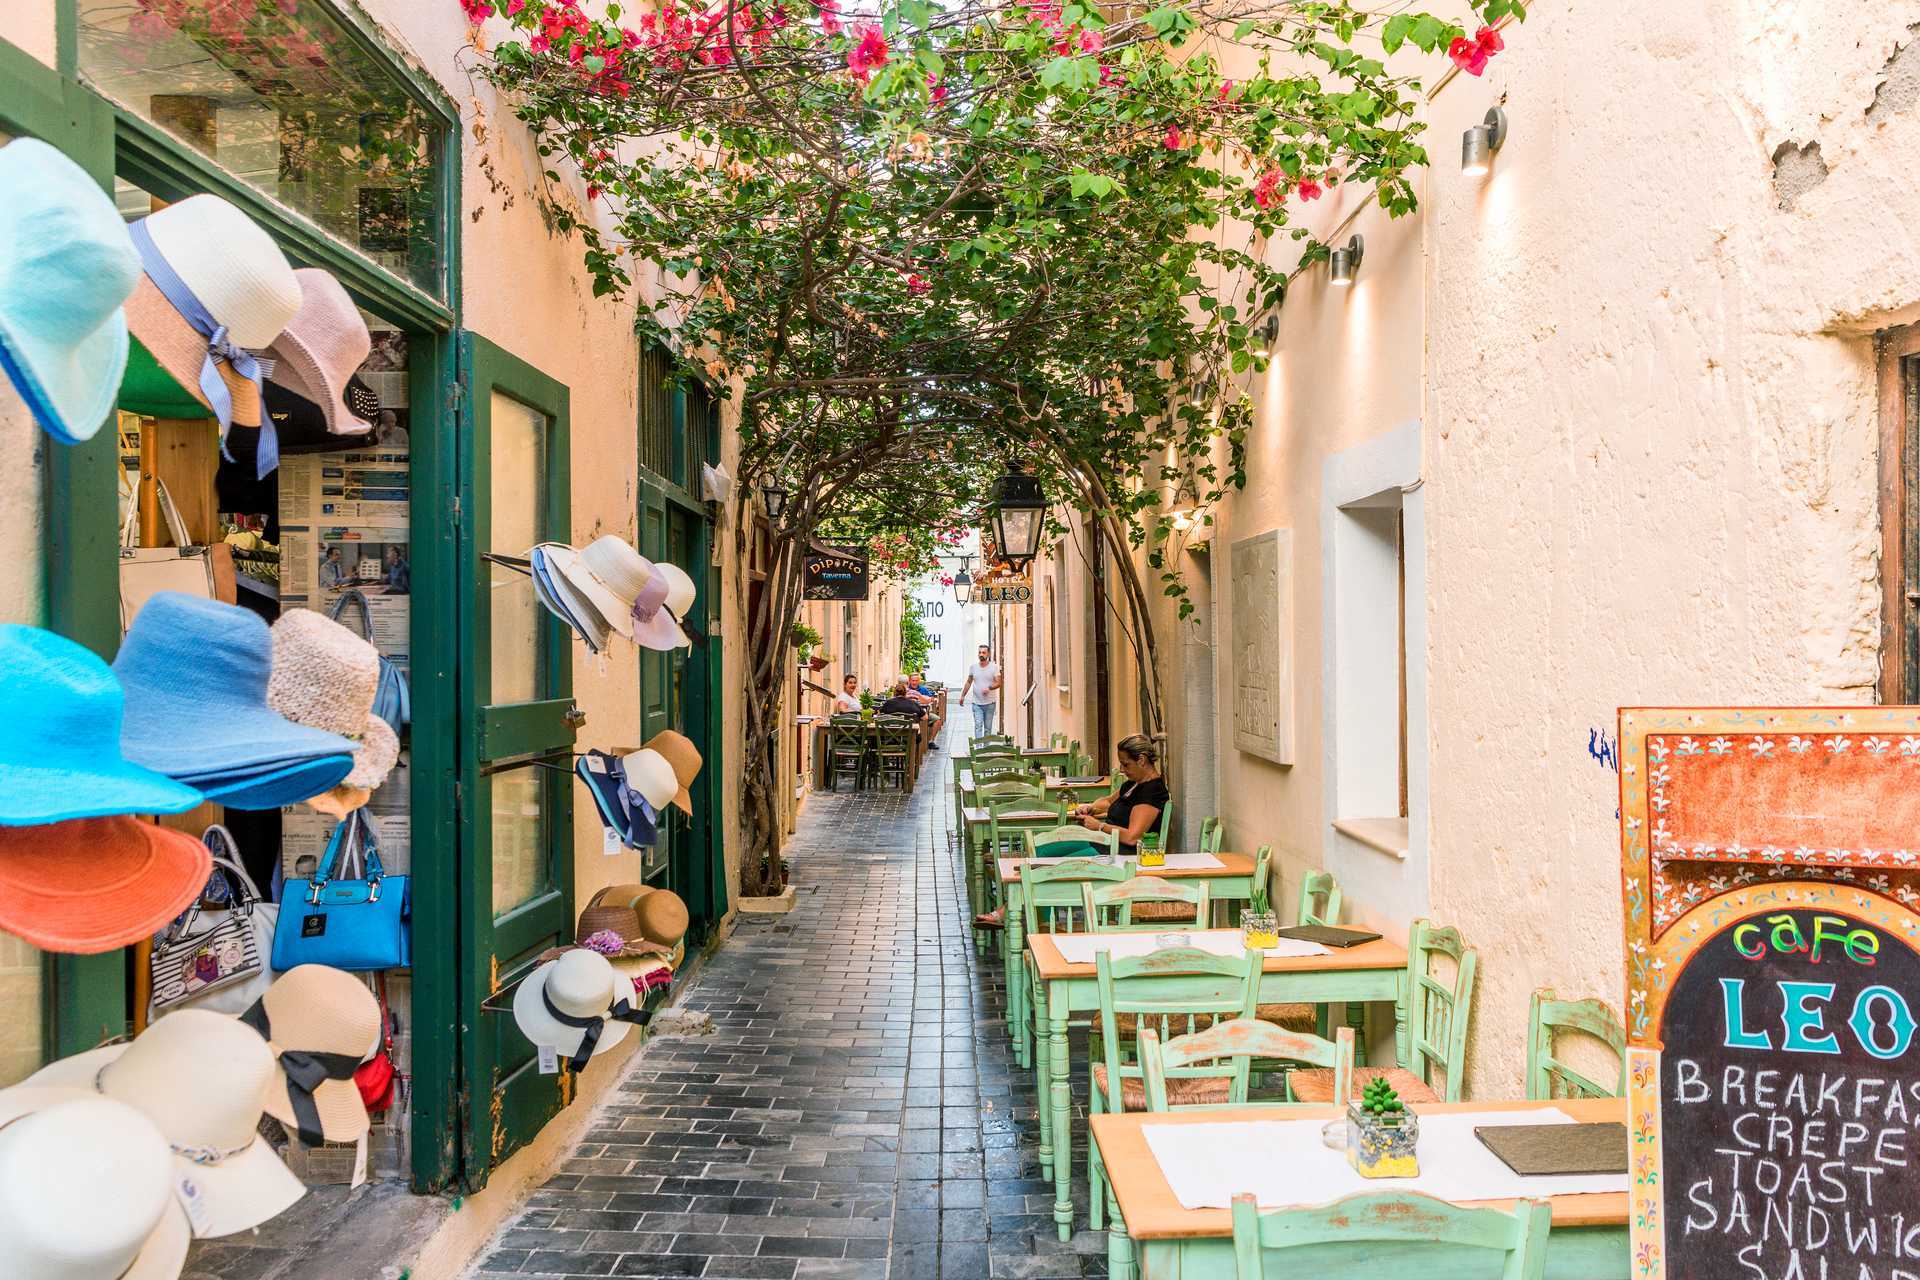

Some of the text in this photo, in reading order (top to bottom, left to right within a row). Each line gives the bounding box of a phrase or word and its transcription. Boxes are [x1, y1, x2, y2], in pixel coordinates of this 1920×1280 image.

[984, 586, 1031, 601] LEO
[1719, 978, 1918, 1060] LEO
[1715, 1149, 1884, 1206] TOAST
